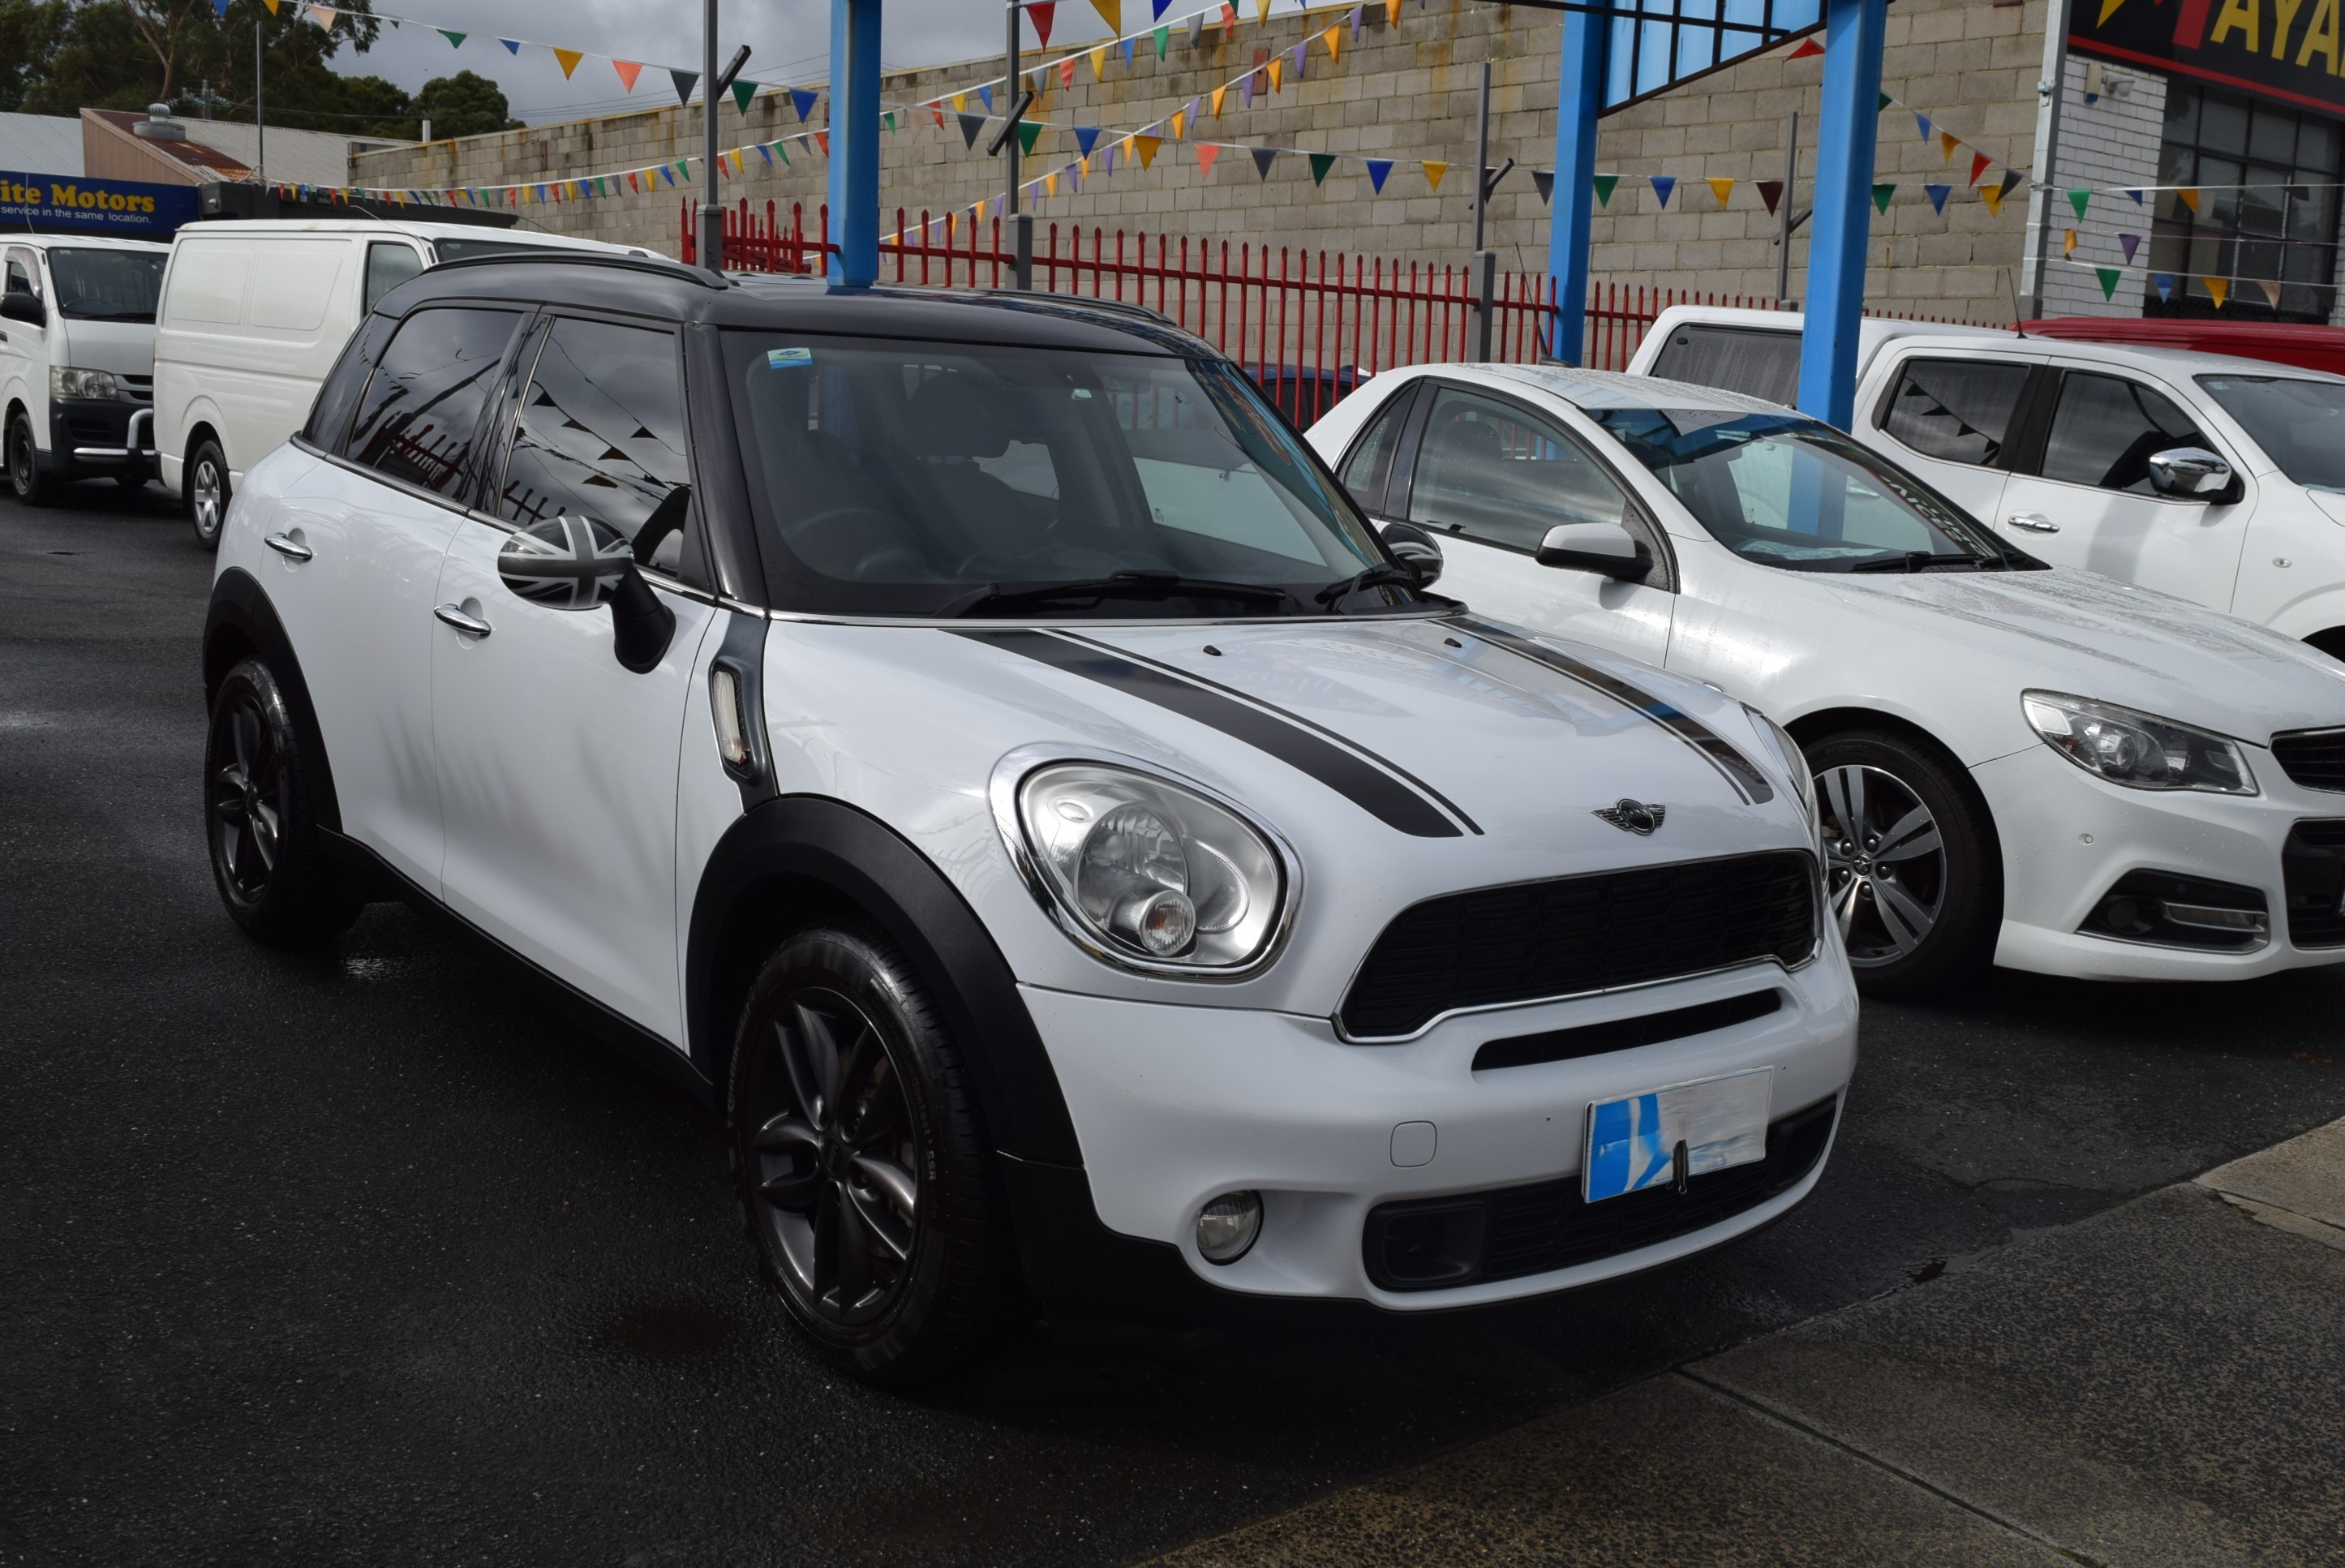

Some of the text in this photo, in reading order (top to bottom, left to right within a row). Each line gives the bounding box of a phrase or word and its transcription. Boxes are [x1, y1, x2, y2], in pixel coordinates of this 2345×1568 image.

[50, 183, 156, 213] Motors
[1, 205, 152, 224] service in the same location.
